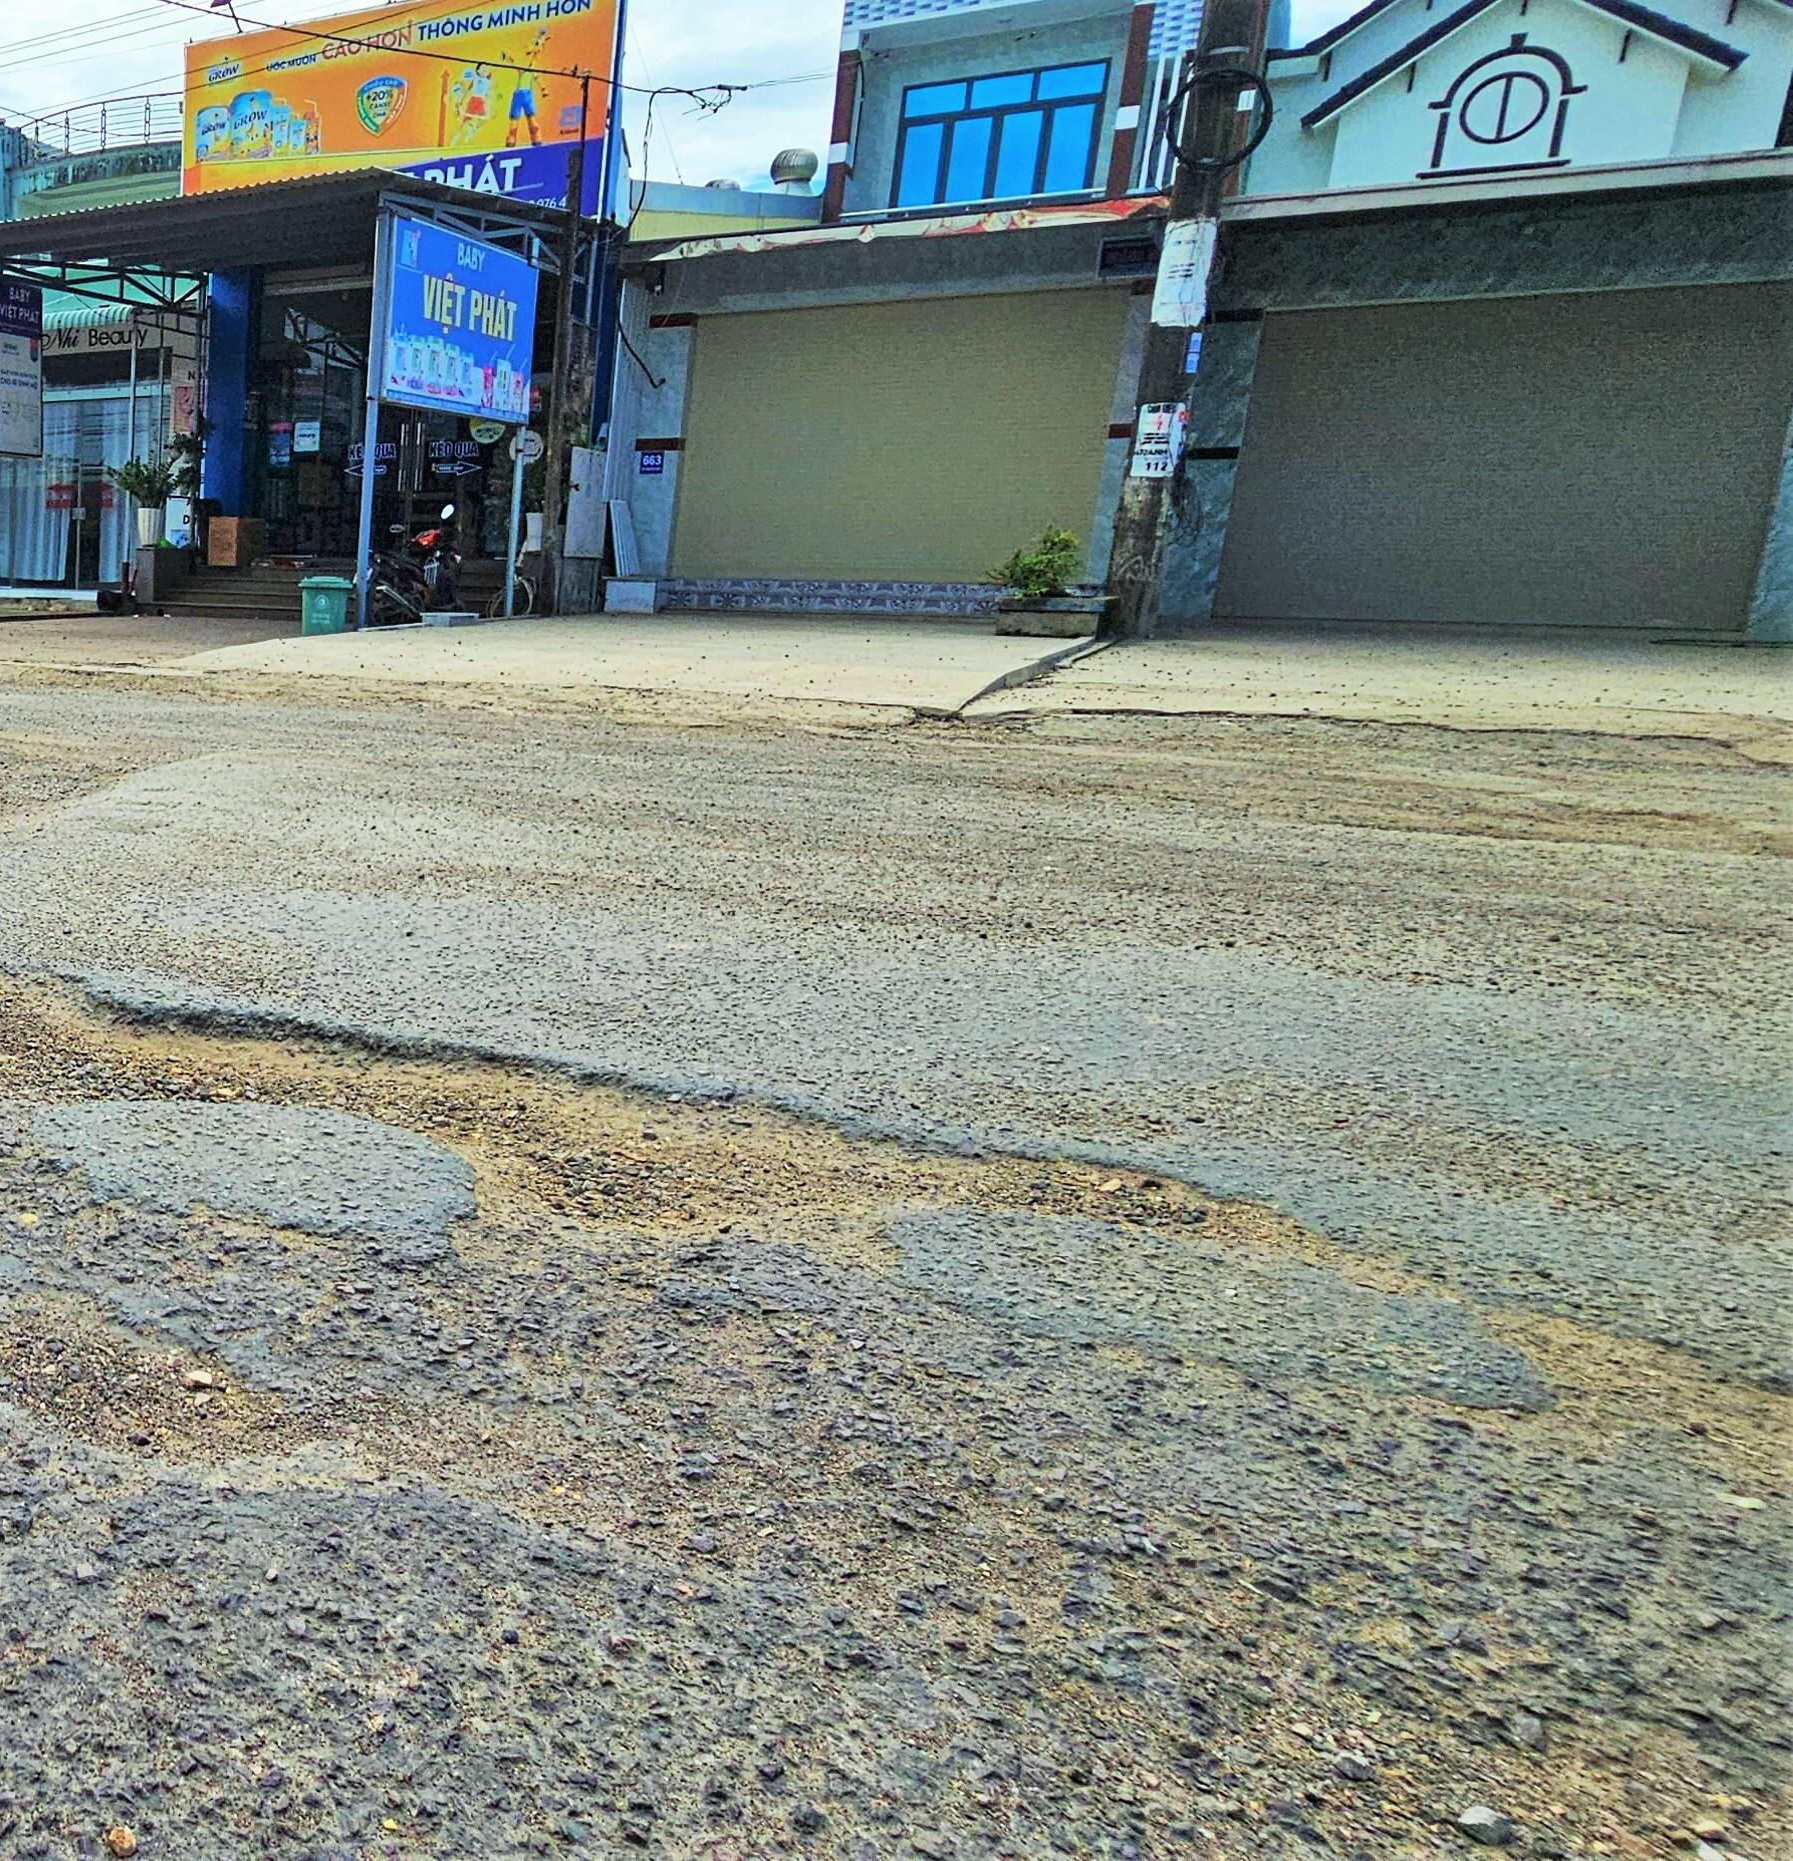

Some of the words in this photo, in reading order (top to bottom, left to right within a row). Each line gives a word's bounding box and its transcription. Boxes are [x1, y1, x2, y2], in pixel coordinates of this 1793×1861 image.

[322, 36, 362, 60] CAO
[418, 14, 482, 41] THÔNG
[487, 4, 540, 29] MINH
[457, 243, 485, 272] BABY
[9, 286, 30, 303] BABY
[423, 272, 466, 334] VIỆT
[468, 290, 517, 341] PHÁT
[88, 328, 148, 347] Beauy
[454, 441, 479, 459] QUA
[642, 454, 662, 466] 663
